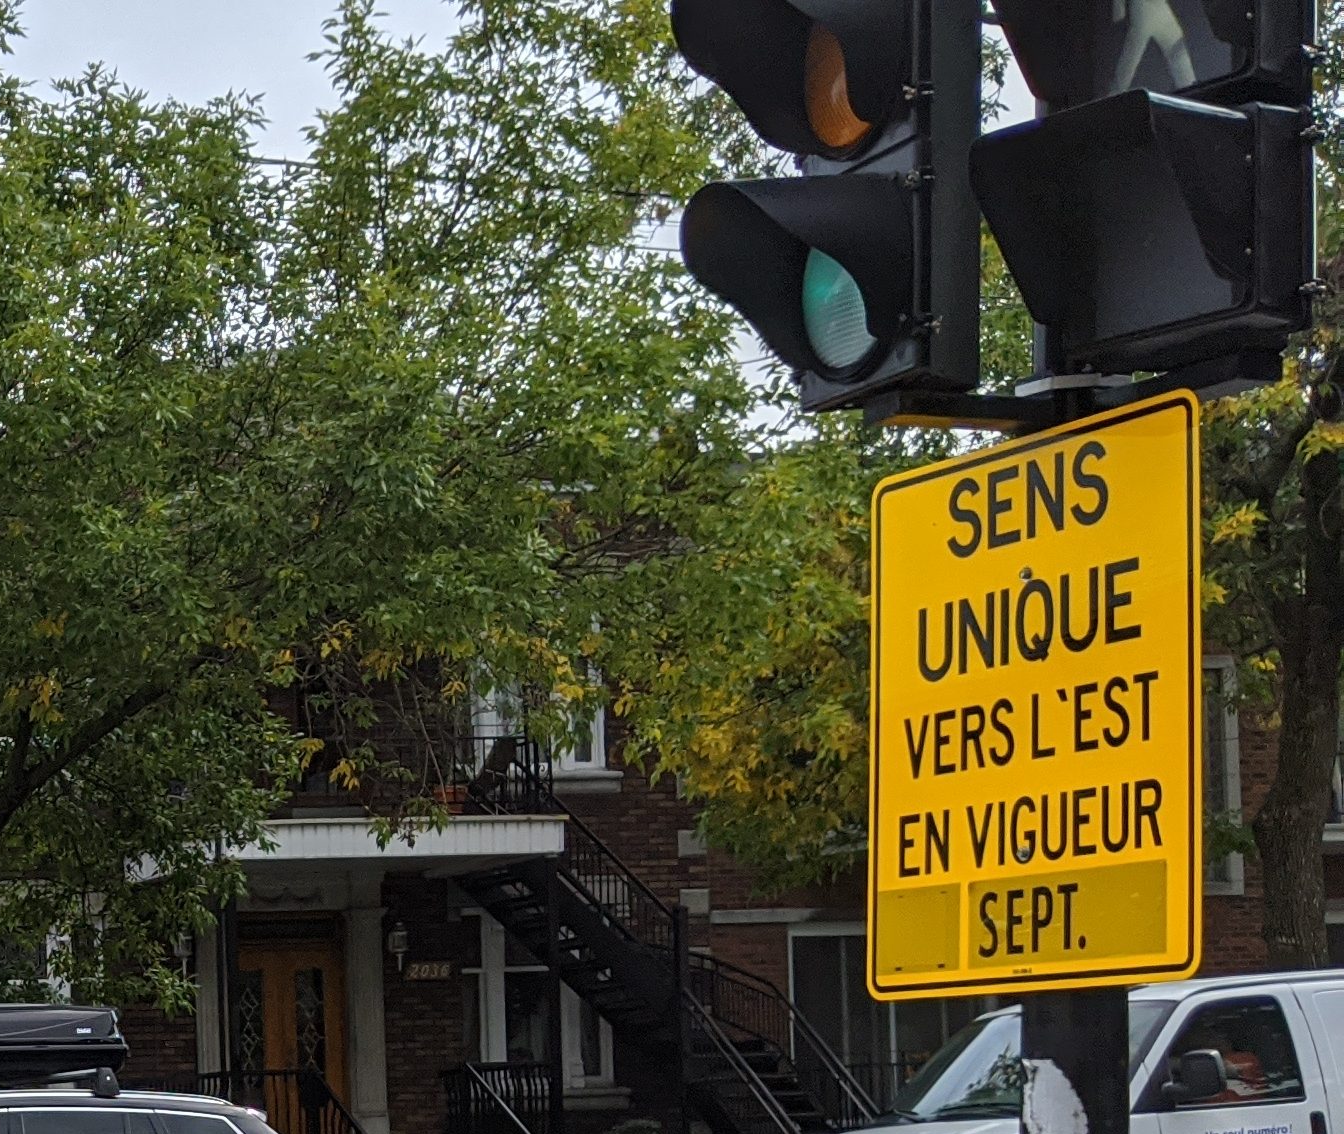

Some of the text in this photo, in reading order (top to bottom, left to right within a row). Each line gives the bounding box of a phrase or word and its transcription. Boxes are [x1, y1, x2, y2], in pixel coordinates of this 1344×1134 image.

[947, 440, 1110, 558] SENS
[917, 557, 1142, 682] UNIQUE
[904, 671, 1159, 780] VERS L'EST
[897, 779, 1163, 878] EN VIGUEUR
[978, 883, 1087, 958] SEPT.
